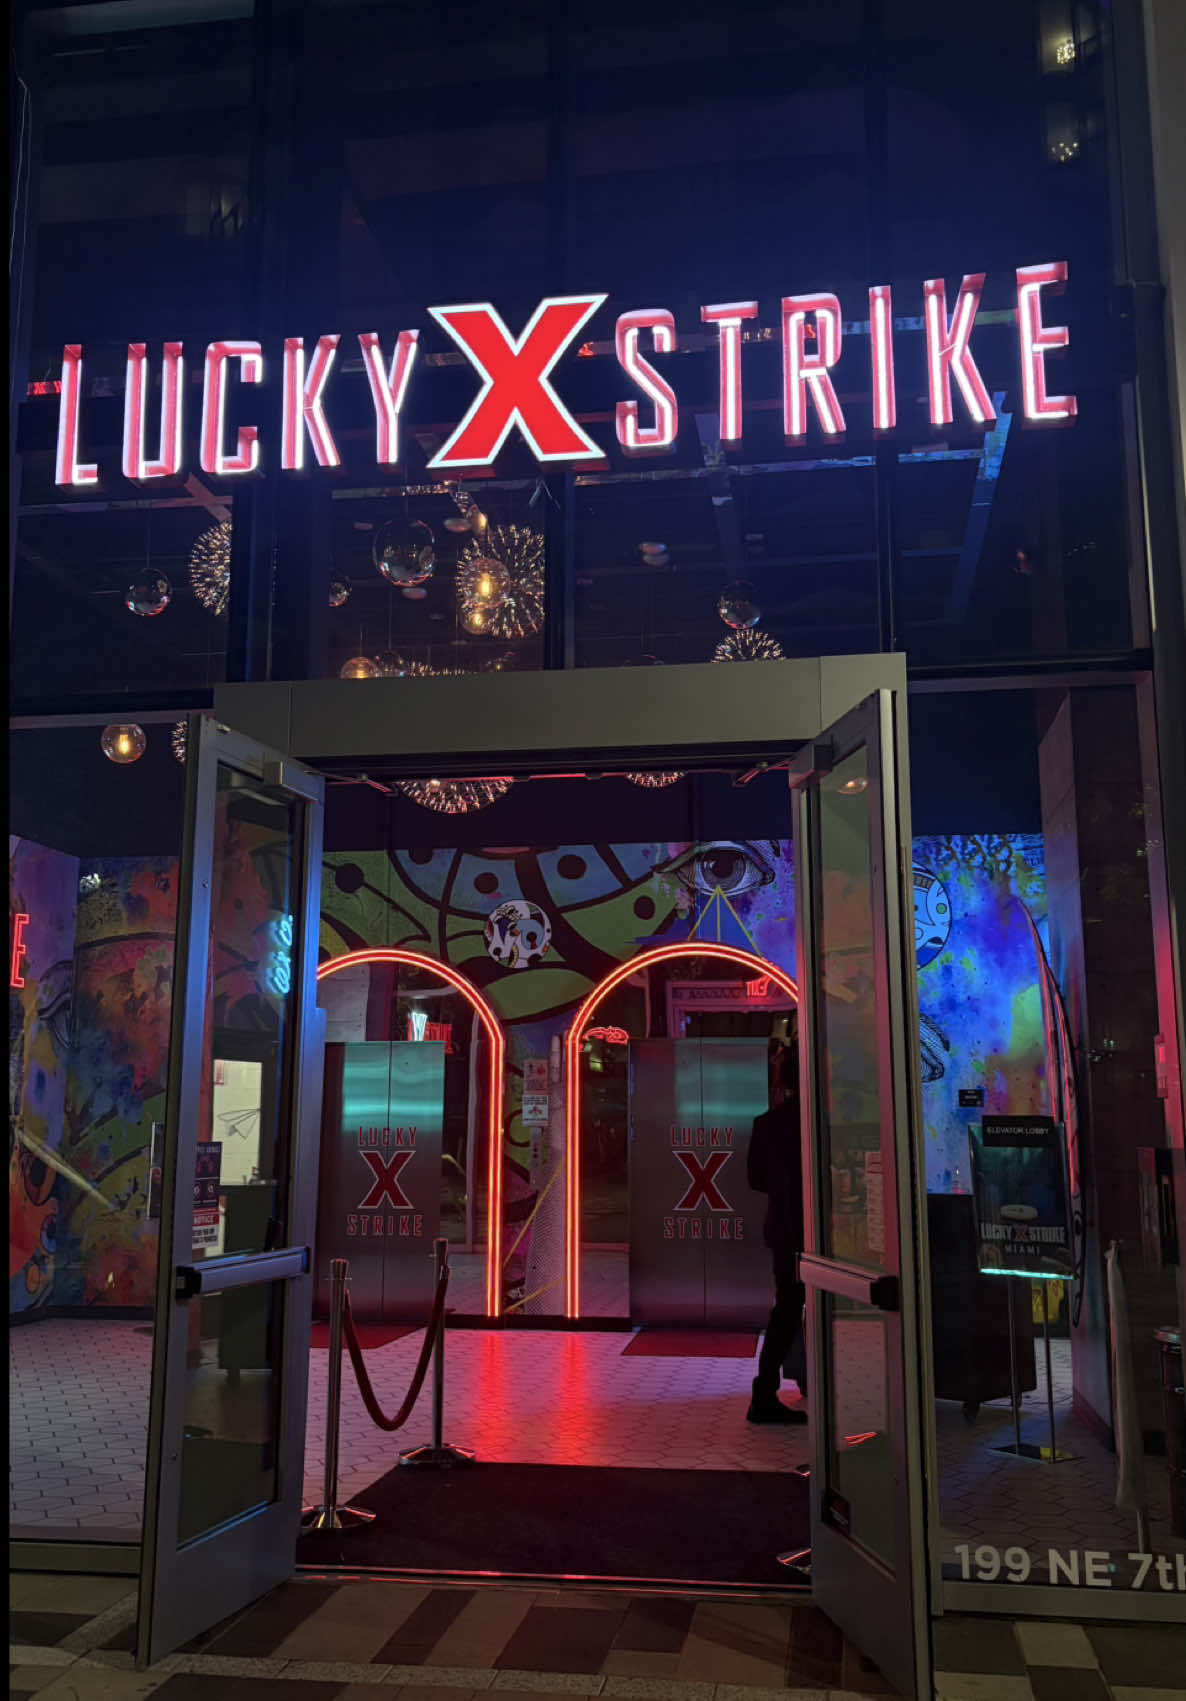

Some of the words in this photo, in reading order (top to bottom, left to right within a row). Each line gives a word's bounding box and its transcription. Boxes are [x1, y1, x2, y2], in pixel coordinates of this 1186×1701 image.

[55, 329, 420, 485] LUCKY
[427, 292, 609, 468] X
[615, 261, 1078, 448] STRIKE
[358, 1126, 417, 1147] LUCKY
[671, 1127, 734, 1147] LUCKY
[987, 1126, 1024, 1135] ELEVATOR
[1025, 1127, 1049, 1135] LOBBY
[357, 1150, 416, 1209] X
[672, 1151, 734, 1211] X
[347, 1215, 423, 1236] STRIKE
[663, 1217, 744, 1240] STRIKE
[981, 1222, 1012, 1241] LUCKY
[1029, 1225, 1065, 1244] STRIKE
[954, 1544, 1031, 1582] 199
[1048, 1548, 1112, 1587] NE
